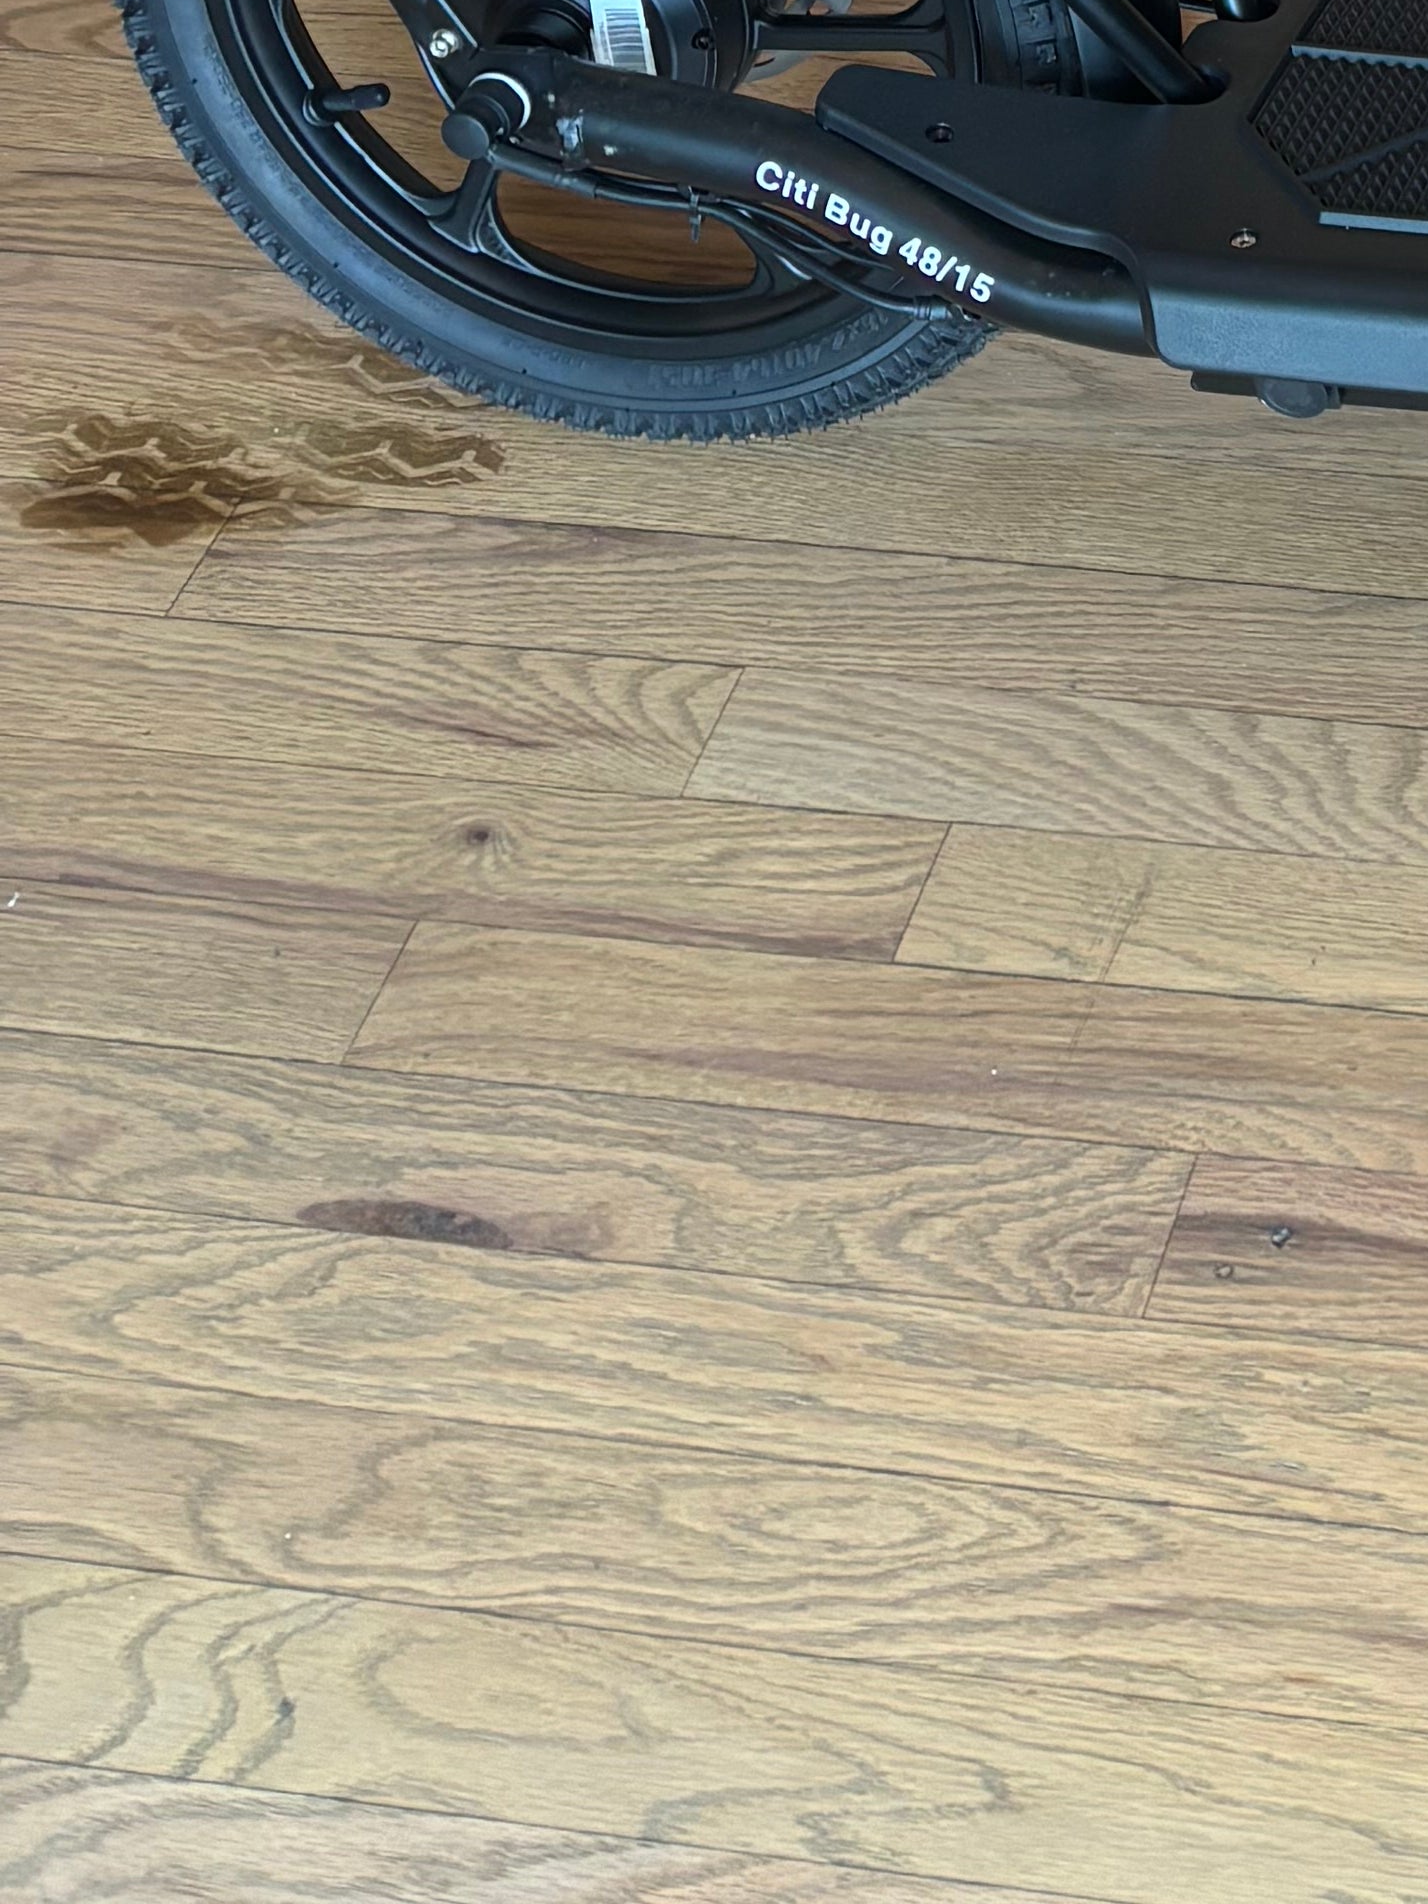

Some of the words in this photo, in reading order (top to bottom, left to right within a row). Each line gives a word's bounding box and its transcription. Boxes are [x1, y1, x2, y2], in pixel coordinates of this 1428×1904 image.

[755, 160, 820, 210] Citi
[824, 192, 894, 256] Bug
[898, 236, 996, 303] 48/15
